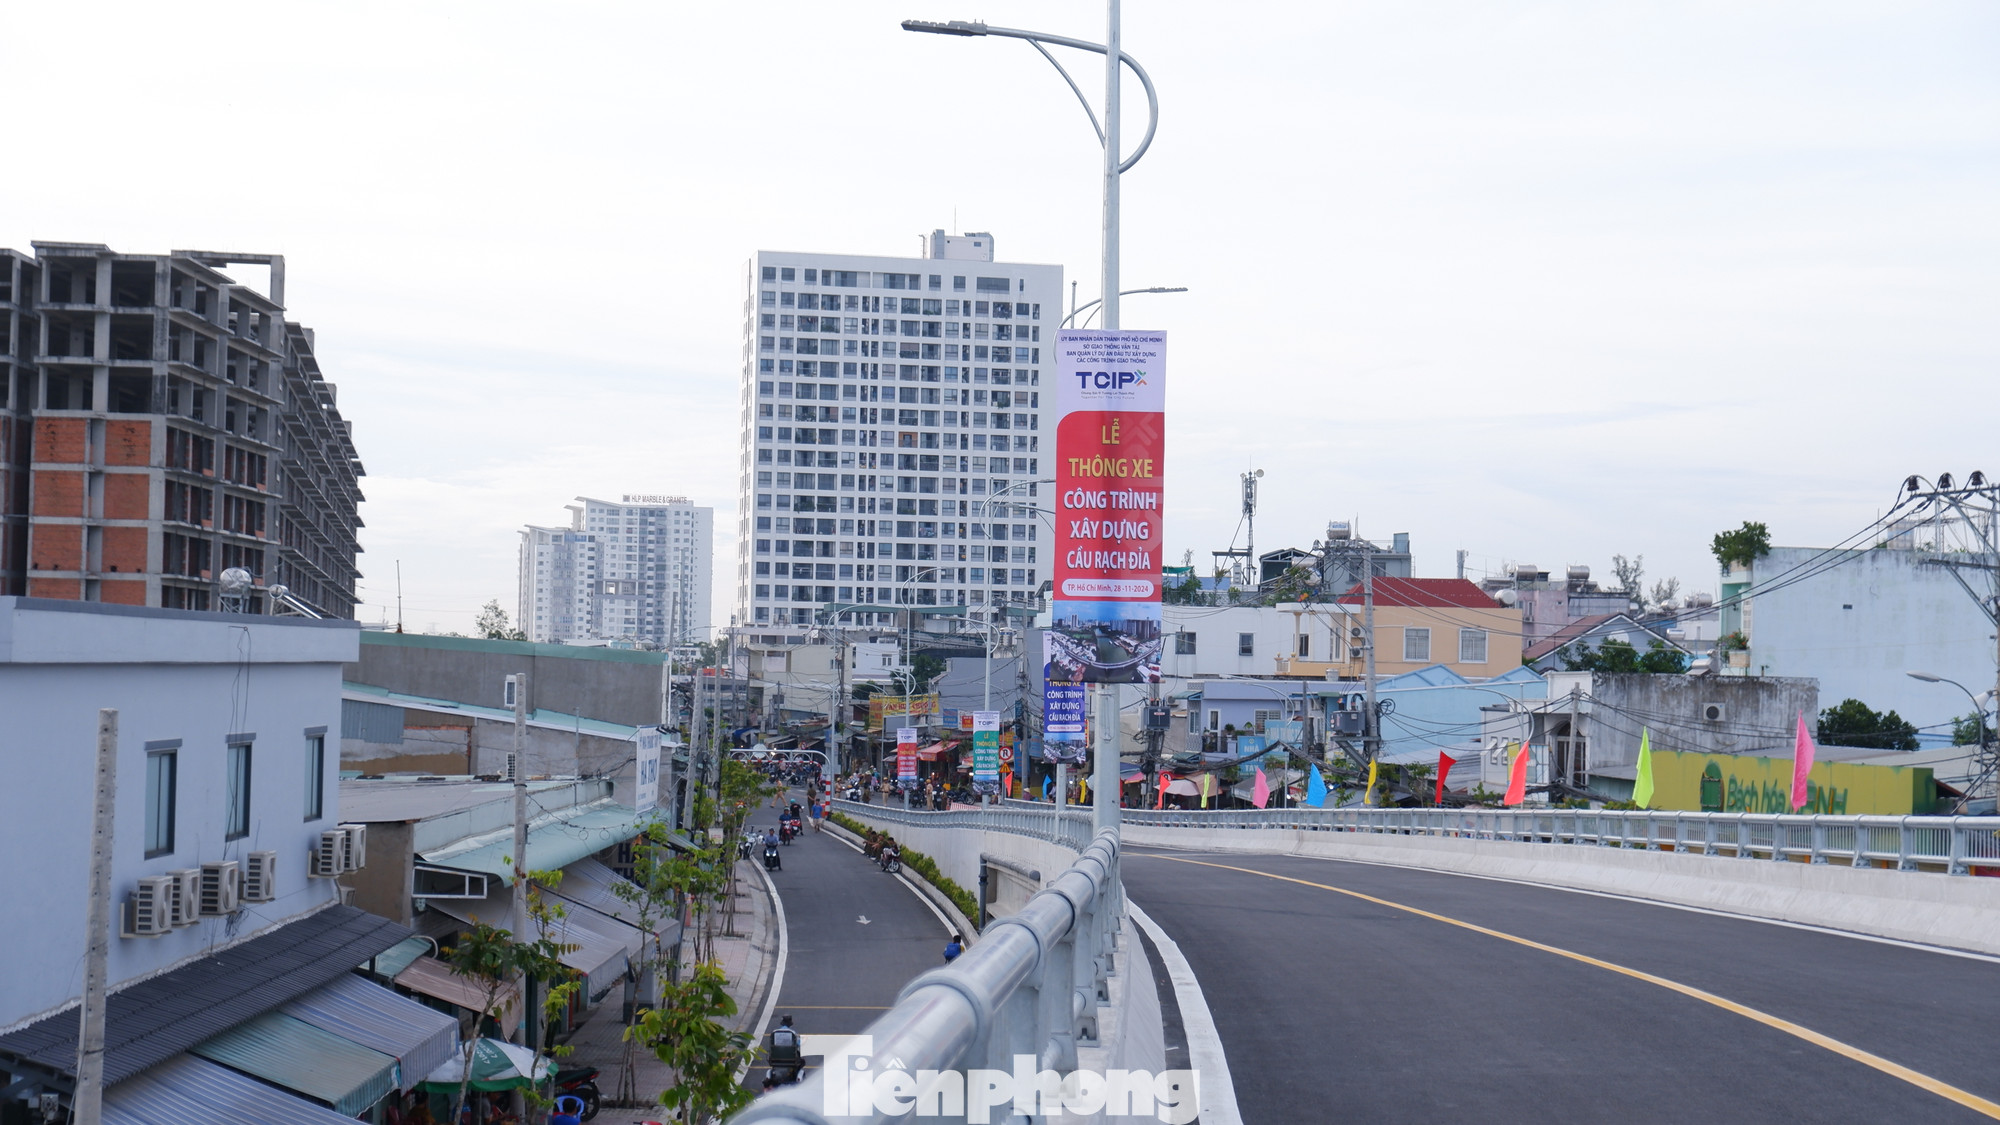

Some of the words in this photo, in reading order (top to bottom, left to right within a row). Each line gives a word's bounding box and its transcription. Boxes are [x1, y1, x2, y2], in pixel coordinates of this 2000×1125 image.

[1076, 372, 1135, 389] TCIP
[1102, 418, 1120, 444] LỄ
[1068, 454, 1128, 478] THÔNG
[1132, 459, 1152, 478] XE
[1064, 487, 1106, 509] CÔNG
[1110, 488, 1156, 510] TRÌNH
[1070, 517, 1099, 539] XÂY
[1102, 518, 1149, 544] DỰNG
[1067, 546, 1092, 569] CẦU
[1095, 551, 1126, 573] RẠCH
[1047, 690, 1064, 698] CÔNG
[1065, 690, 1082, 698] TRÌNH
[1050, 701, 1061, 710] XÂY
[1062, 702, 1080, 711] DỰNG
[1060, 714, 1072, 723] RẠCH
[1761, 778, 1786, 814] hóa
